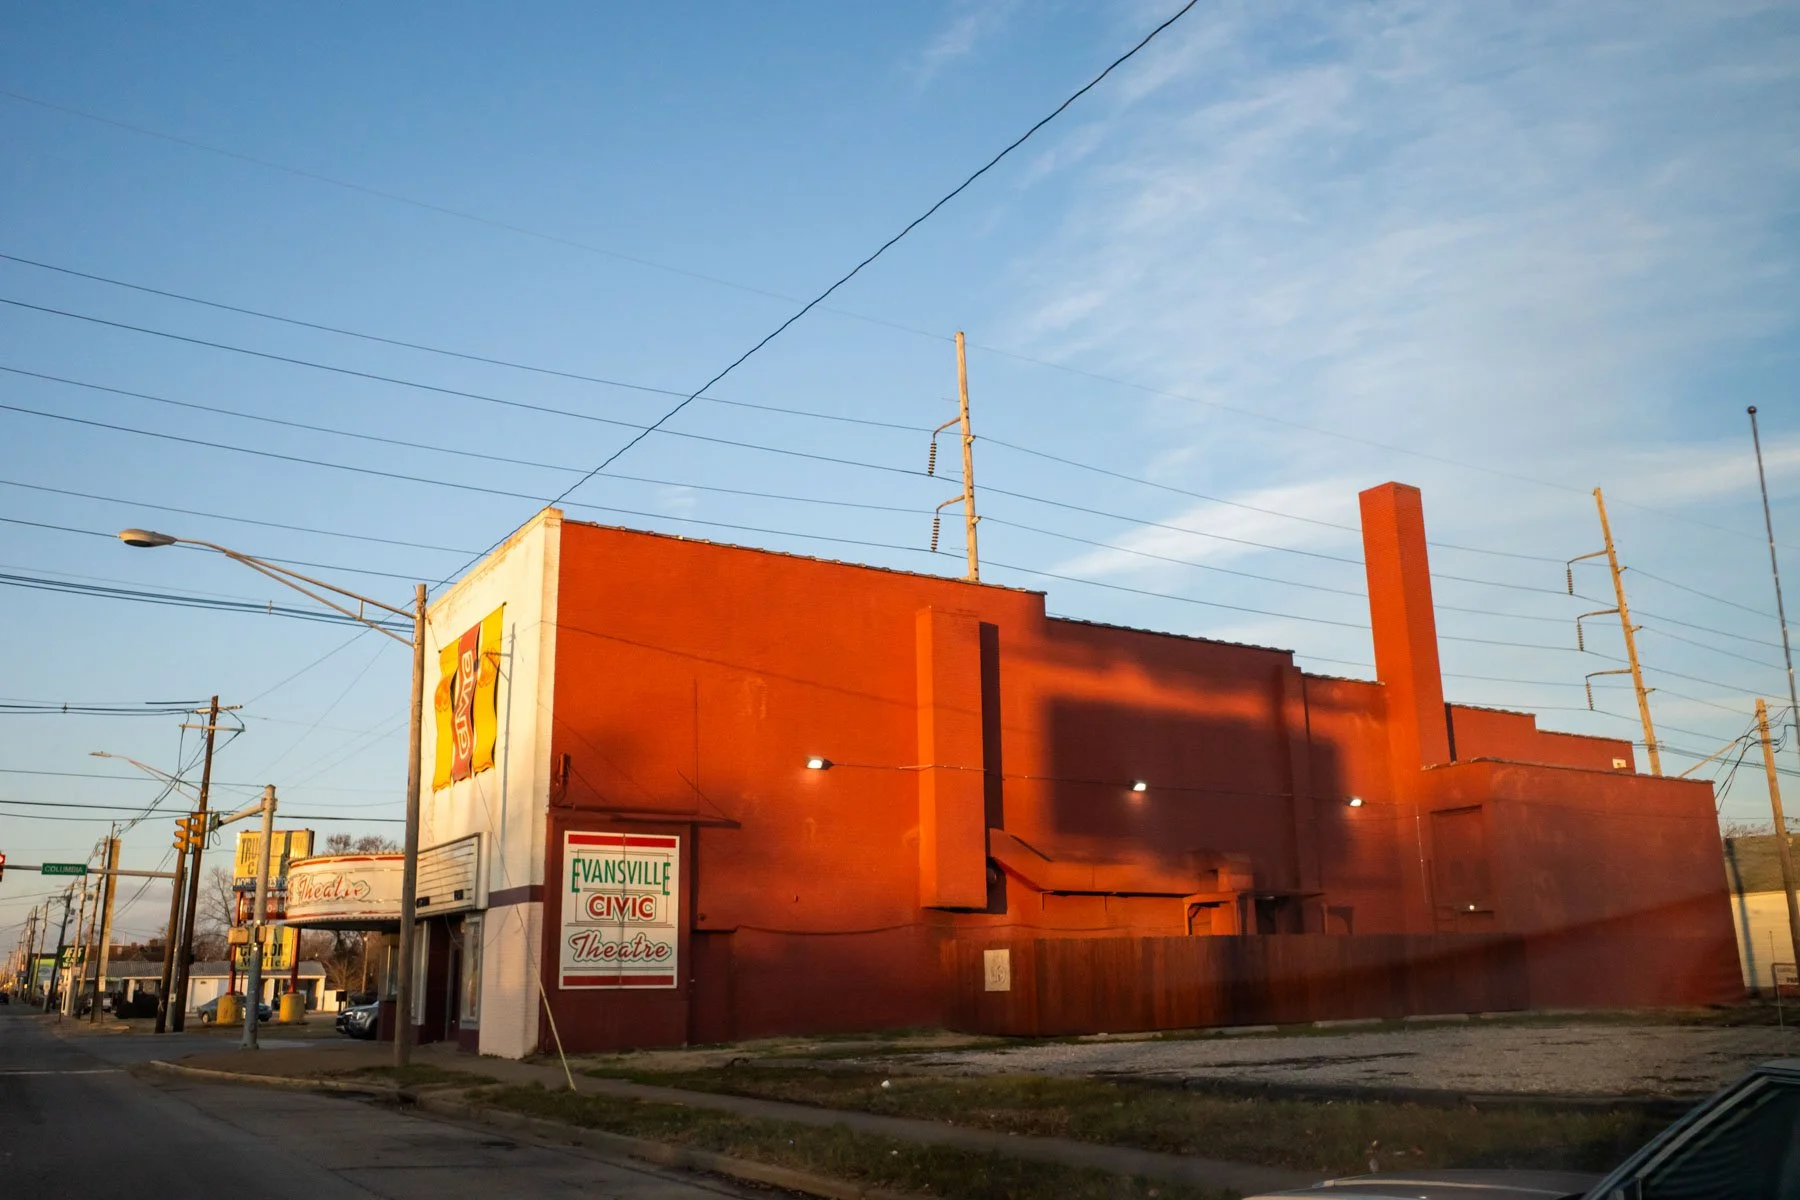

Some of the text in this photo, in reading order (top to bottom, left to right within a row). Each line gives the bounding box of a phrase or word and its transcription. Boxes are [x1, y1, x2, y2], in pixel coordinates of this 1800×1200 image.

[454, 649, 475, 760] CIVIC
[44, 865, 83, 874] COLUMBIA
[571, 857, 671, 896] EVANSVILLE
[588, 894, 655, 919] CIVIC
[571, 931, 671, 960] Theatre
